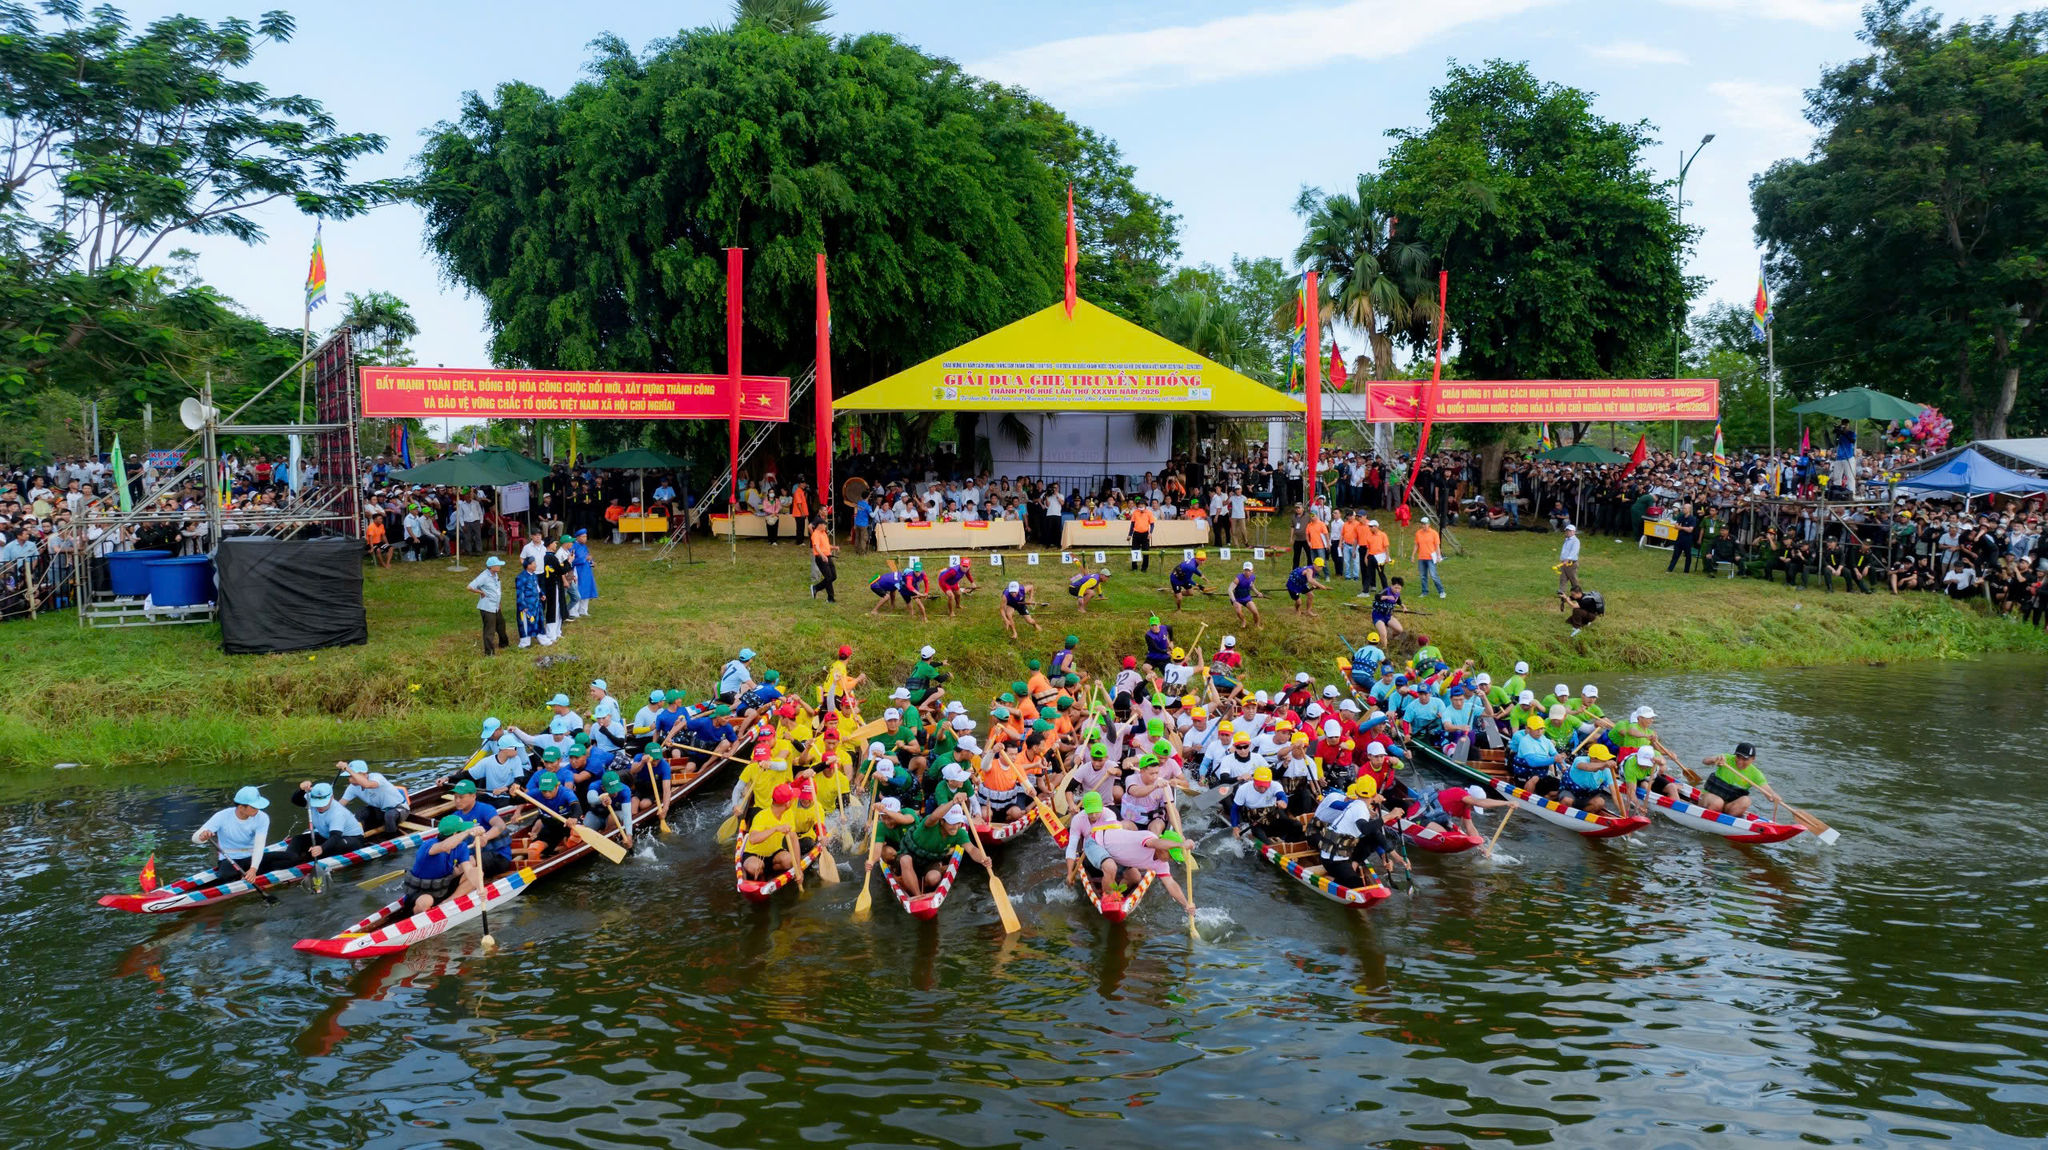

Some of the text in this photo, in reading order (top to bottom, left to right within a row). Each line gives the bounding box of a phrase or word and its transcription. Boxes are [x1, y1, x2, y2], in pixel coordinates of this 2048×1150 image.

[944, 369, 984, 387] GIẢI
[1029, 374, 1065, 387] GHE
[1069, 369, 1139, 387] TRUYỀN
[1144, 369, 1202, 387] THỐNG
[396, 378, 425, 393] MẠNH
[426, 376, 451, 391] TOÀN
[504, 379, 518, 395] BỘ
[519, 378, 537, 393] HÓA
[538, 378, 562, 394] CÔNG
[564, 380, 587, 396] CUỘC
[624, 381, 641, 395] XÂY
[642, 382, 665, 397] DỰNG
[666, 382, 692, 396] THÀNH
[693, 382, 715, 396] CÔNG
[989, 387, 1018, 395] THÀNH
[1018, 386, 1036, 395] PHỐ
[1037, 386, 1054, 395] HUẾ
[1055, 386, 1072, 395] LẦN
[1073, 386, 1090, 395] THỨ
[1119, 387, 1139, 395] NĂM
[1509, 386, 1528, 399] CÁCH
[1550, 387, 1572, 399] THÁNG
[1573, 386, 1588, 399] TÁM
[1589, 386, 1611, 399] THÀNH
[1611, 386, 1630, 399] CÔNG
[423, 395, 436, 410] VÀ
[437, 394, 457, 410] BẢO
[458, 395, 470, 412] VỆ
[471, 396, 496, 410] VỮNG
[522, 394, 535, 411] TỔ
[535, 395, 559, 411] QUỐC
[559, 397, 578, 413] VIỆT
[579, 399, 599, 412] NAM
[600, 398, 613, 412] XÃ
[613, 398, 628, 414] HỘI
[629, 397, 646, 412] CHỦ
[1436, 402, 1446, 414] VÀ
[1446, 400, 1465, 415] QUỐC
[1510, 402, 1529, 416] CỘNG
[1603, 400, 1619, 415] VIỆT
[1619, 402, 1635, 413] NAM
[1164, 669, 1180, 685] 12
